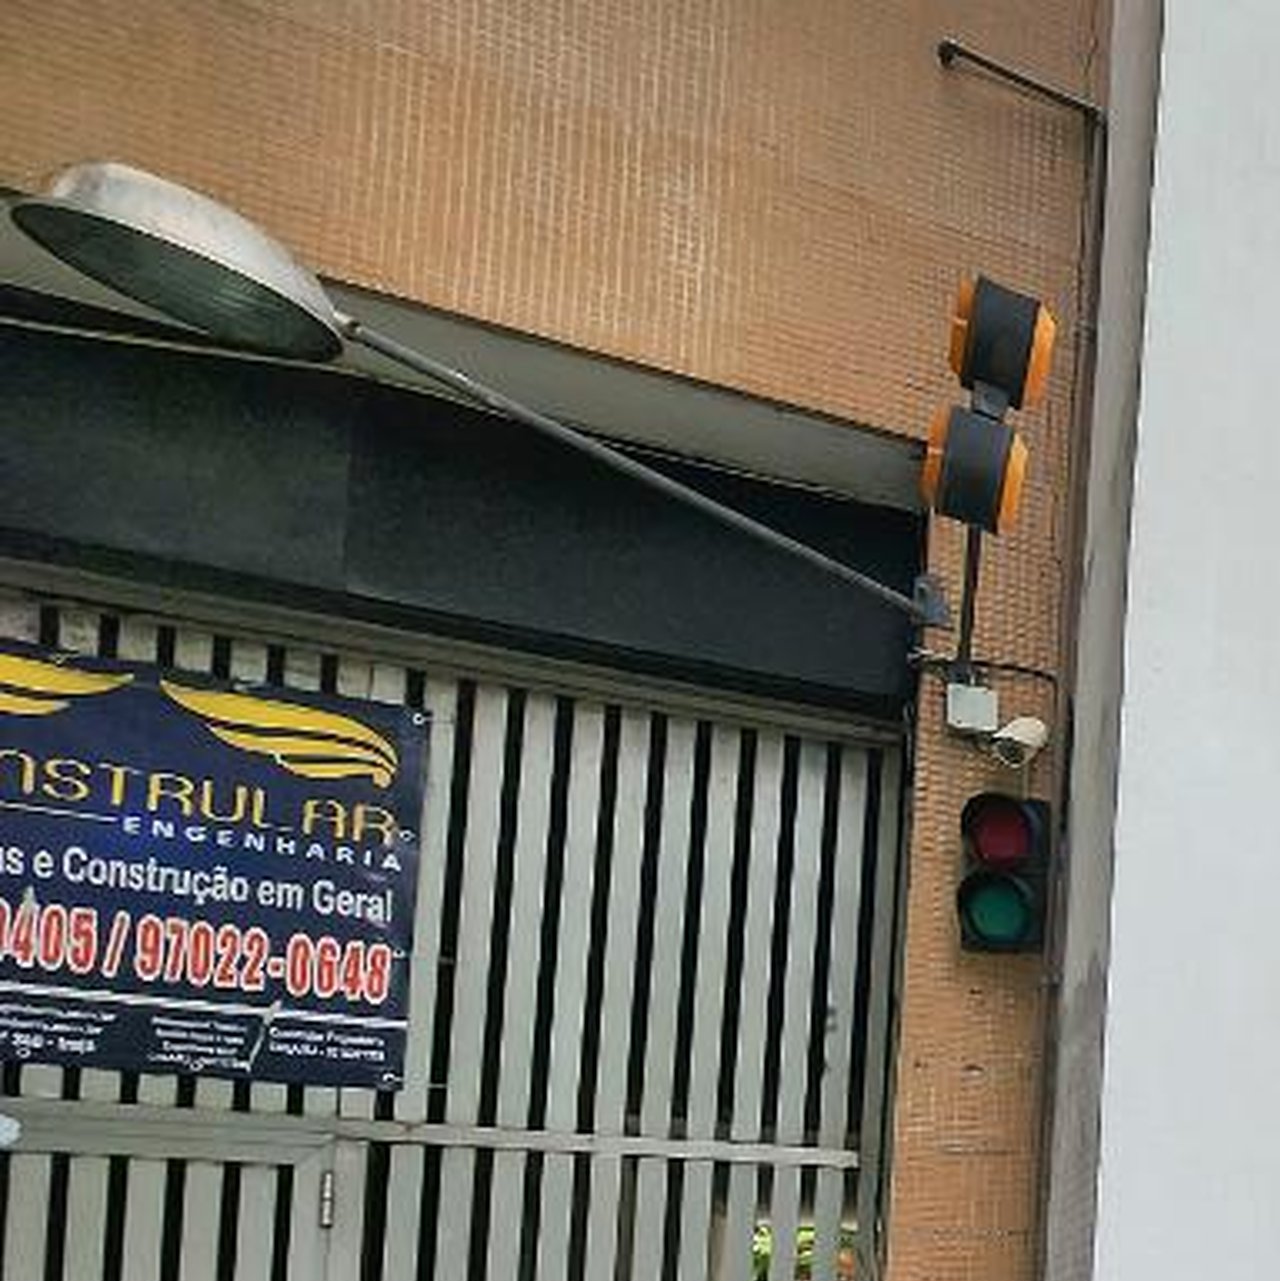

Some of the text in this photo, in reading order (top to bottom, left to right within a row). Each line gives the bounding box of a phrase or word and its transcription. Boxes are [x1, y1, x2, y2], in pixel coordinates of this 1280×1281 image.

[122, 816, 401, 872] ENGENHARIA
[0, 846, 393, 923] s e Construção em Geral
[136, 914, 392, 1004] 97022-0648
